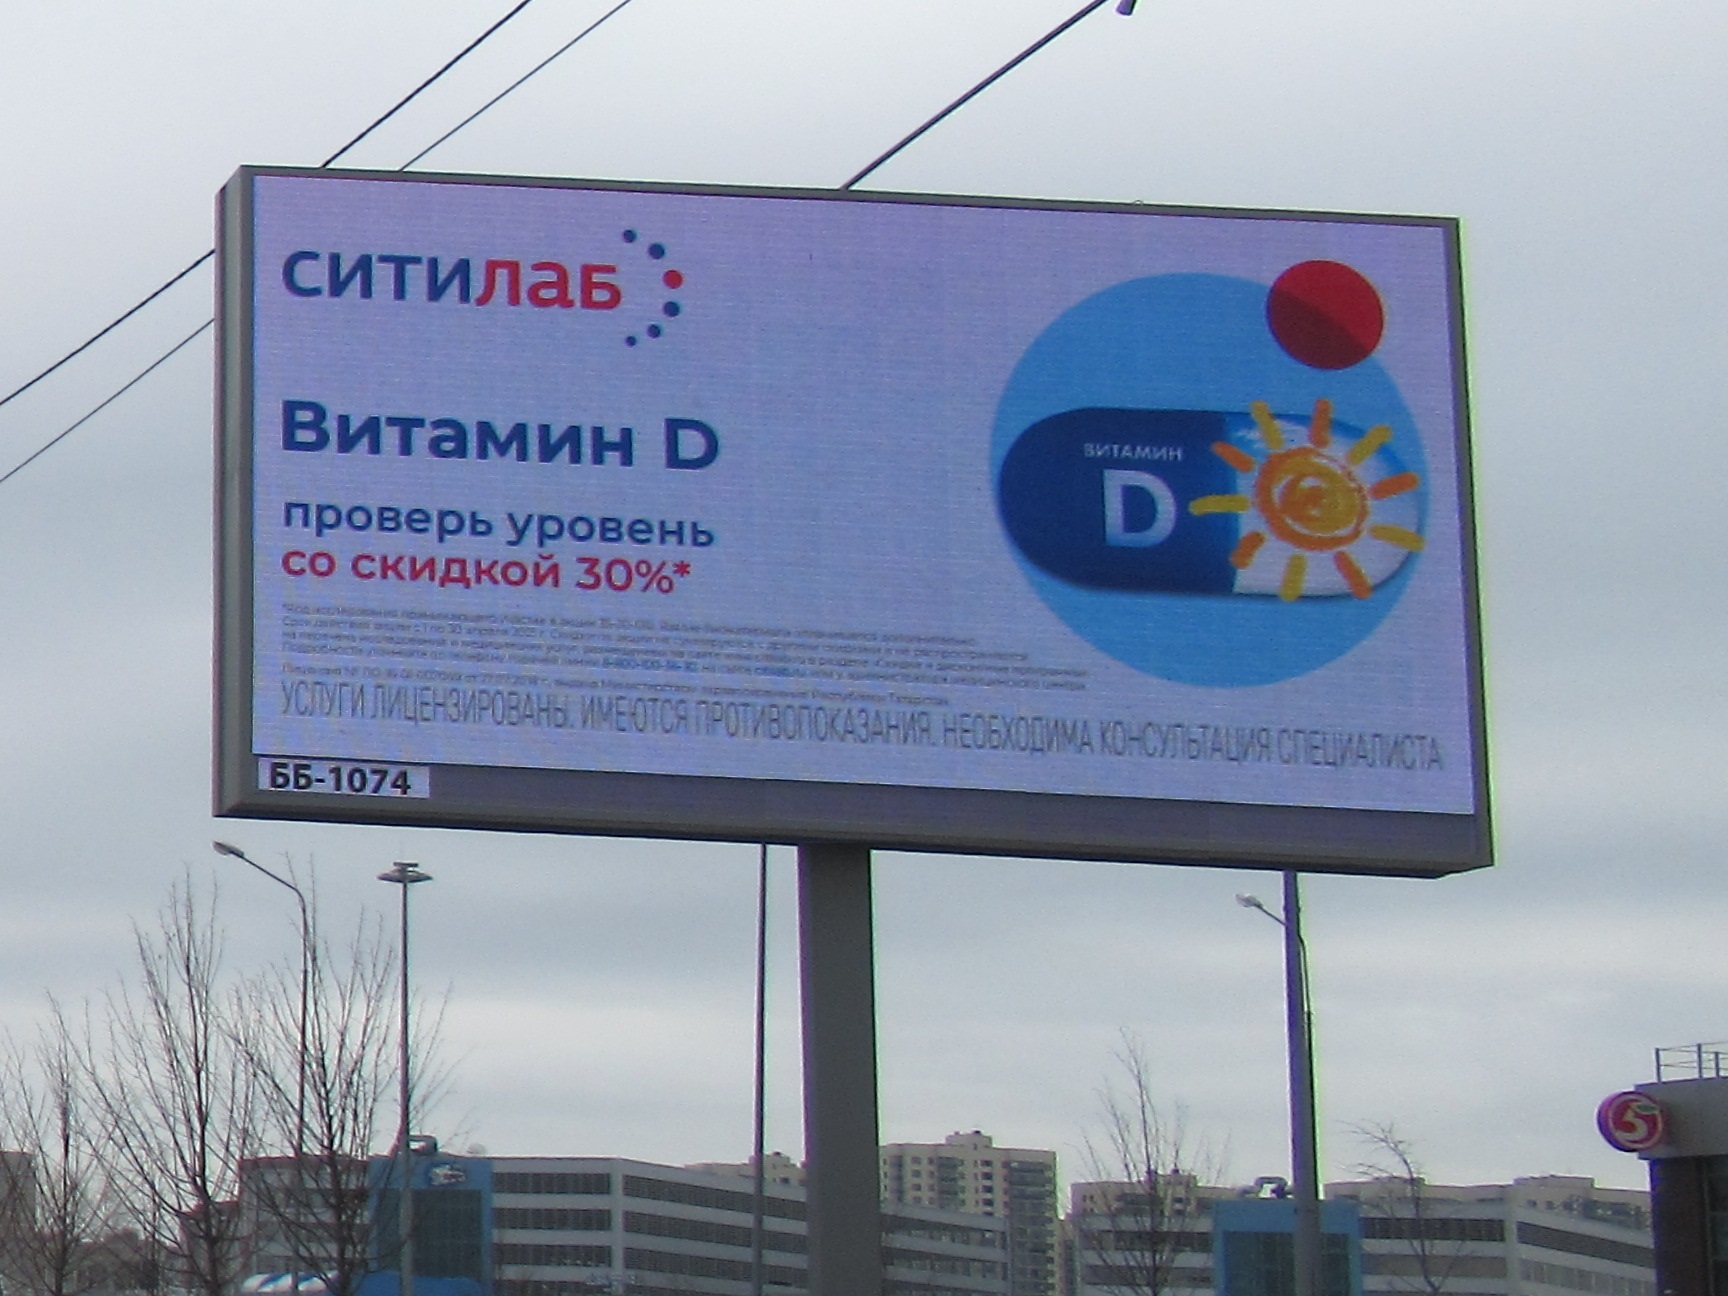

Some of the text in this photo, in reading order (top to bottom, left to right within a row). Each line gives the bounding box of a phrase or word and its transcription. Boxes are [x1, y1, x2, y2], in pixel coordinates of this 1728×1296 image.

[281, 249, 622, 311] ситилаб
[281, 398, 721, 471] Витамин D
[1083, 442, 1184, 463] ВИТАМИН
[283, 500, 716, 549] проверь уровень
[1102, 467, 1178, 550] D
[281, 550, 336, 578] со
[351, 551, 560, 590] скидкой
[281, 679, 365, 718] УСЛУГИ
[581, 695, 688, 735] ИМЕЮТСЯ
[944, 712, 1094, 755] НЕОБХОДИМА
[1100, 720, 1271, 765] КОНСУЛЬТАЦИЯ
[1278, 728, 1444, 771] СПЕЦИАЛИСТА
[269, 761, 412, 797] ББ-1074
